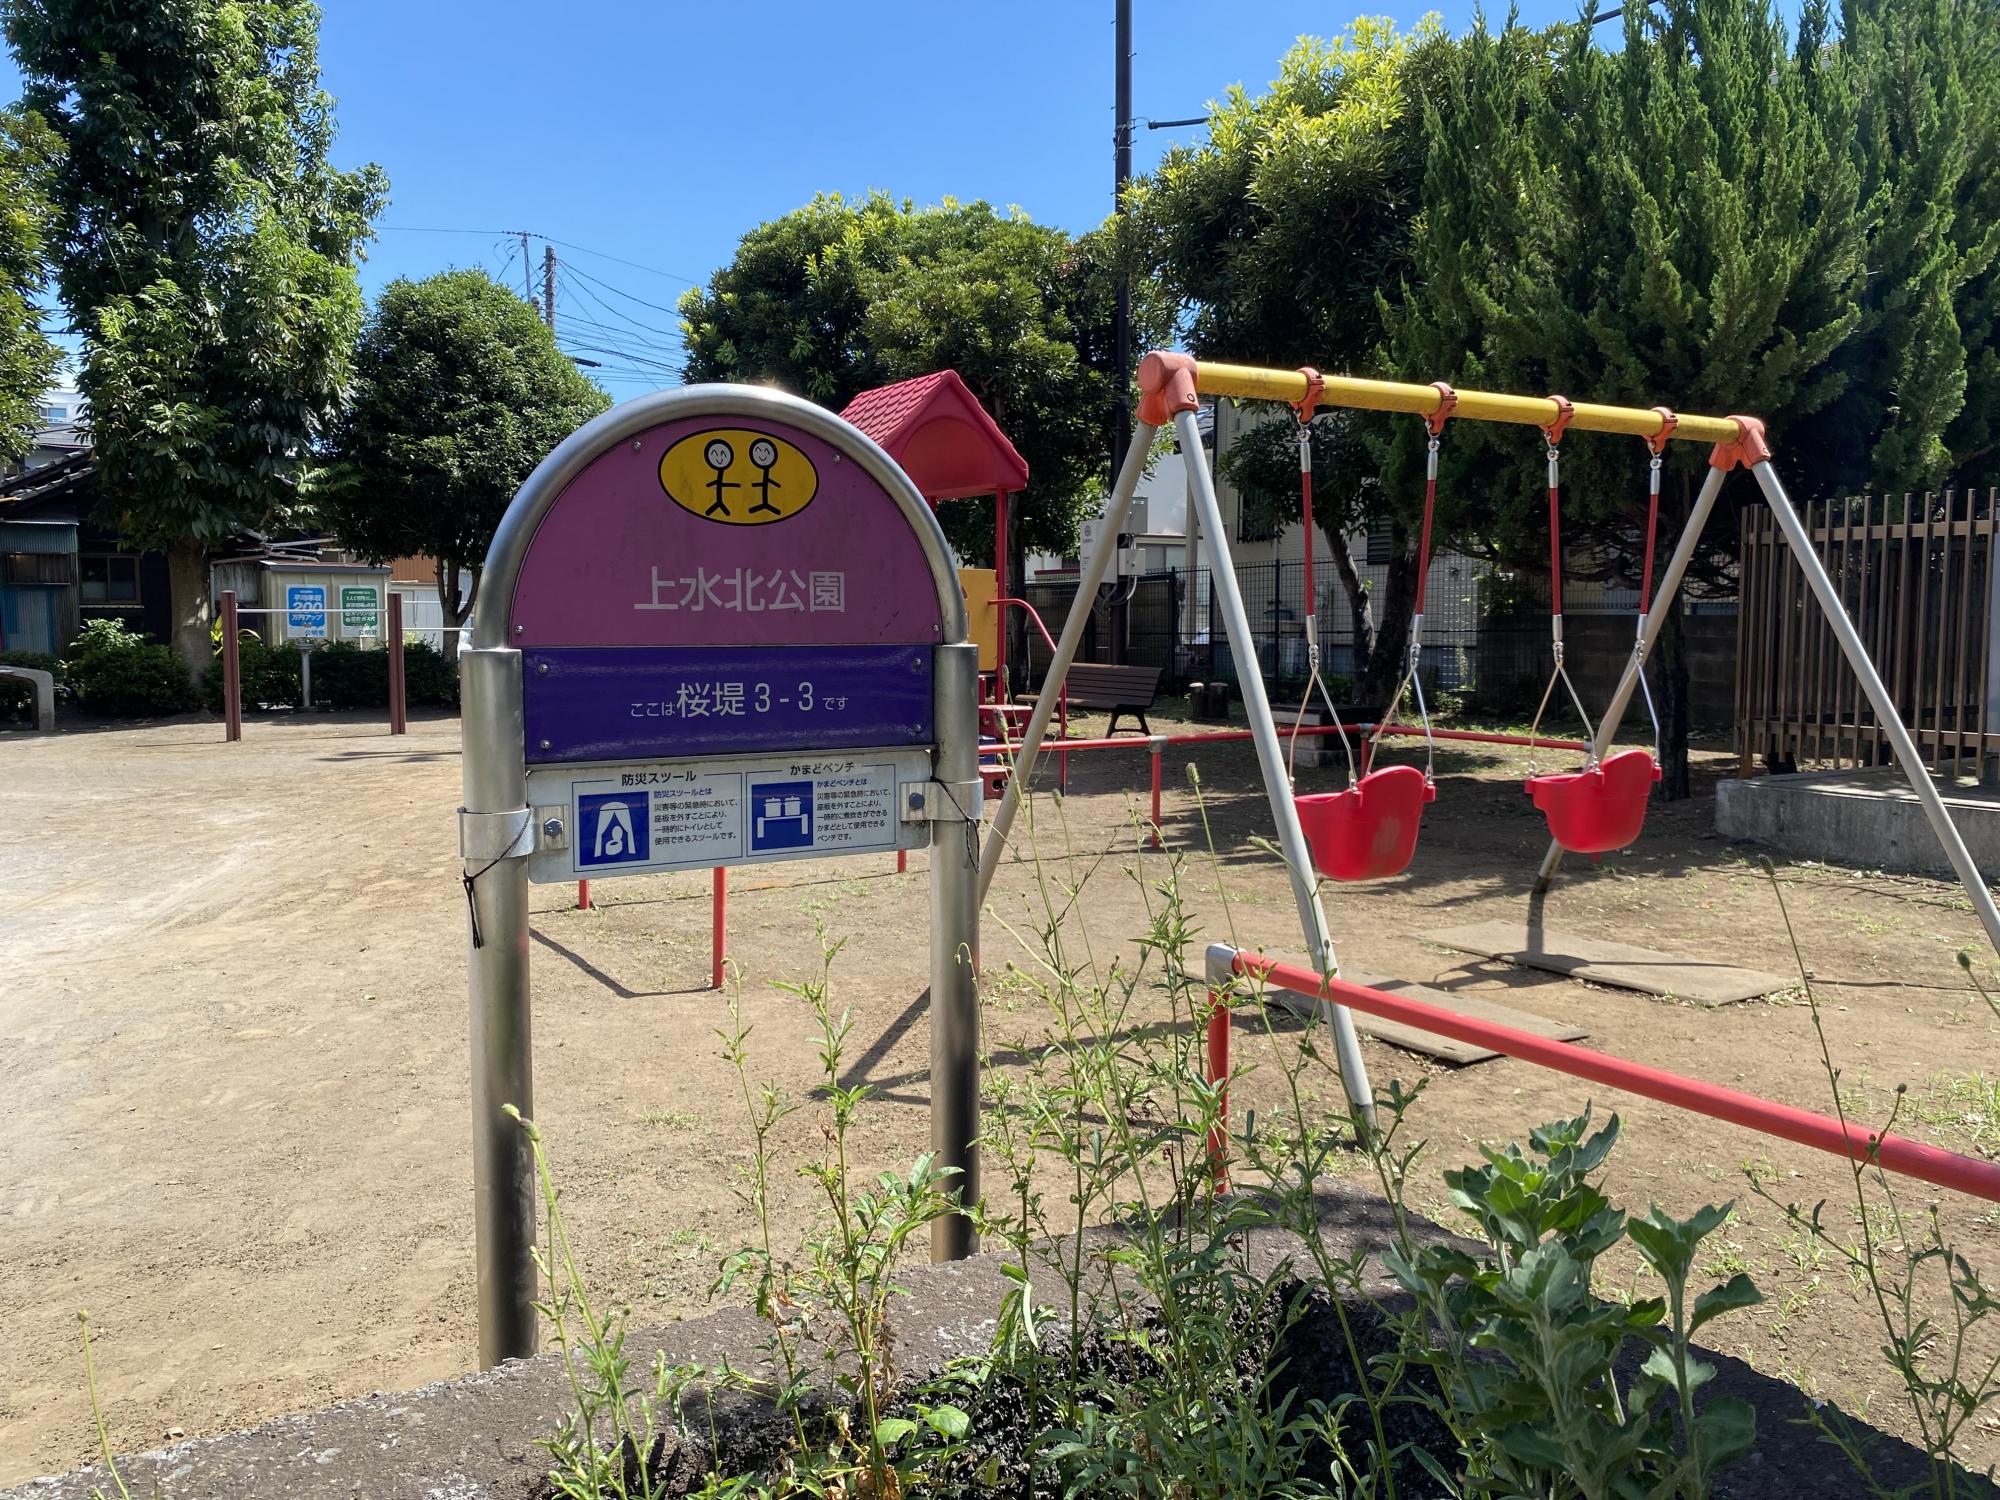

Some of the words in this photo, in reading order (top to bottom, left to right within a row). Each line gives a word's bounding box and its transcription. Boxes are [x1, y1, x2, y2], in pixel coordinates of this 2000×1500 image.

[634, 566, 845, 612] 上水北公園
[292, 602, 323, 613] 200
[790, 762, 855, 776] かまどベンチ
[621, 770, 697, 786] 防災スツール
[817, 778, 867, 788] かまどベンチとは
[653, 788, 713, 799] 防災スツールとは
[817, 789, 892, 801] 災害等の緊急時において、
[654, 799, 739, 812] 災害等の緊急時において、
[817, 801, 882, 811] 座板を外すことにより、
[654, 811, 728, 823] 座板を外すことにより、
[817, 810, 888, 820] 一時的に煮炊きができる
[654, 822, 724, 834] 一時的にトイレとして
[817, 820, 885, 832] かまどとして使用できる
[654, 832, 737, 846] 使用できるスツールです。
[817, 833, 852, 842] ベンチです。
